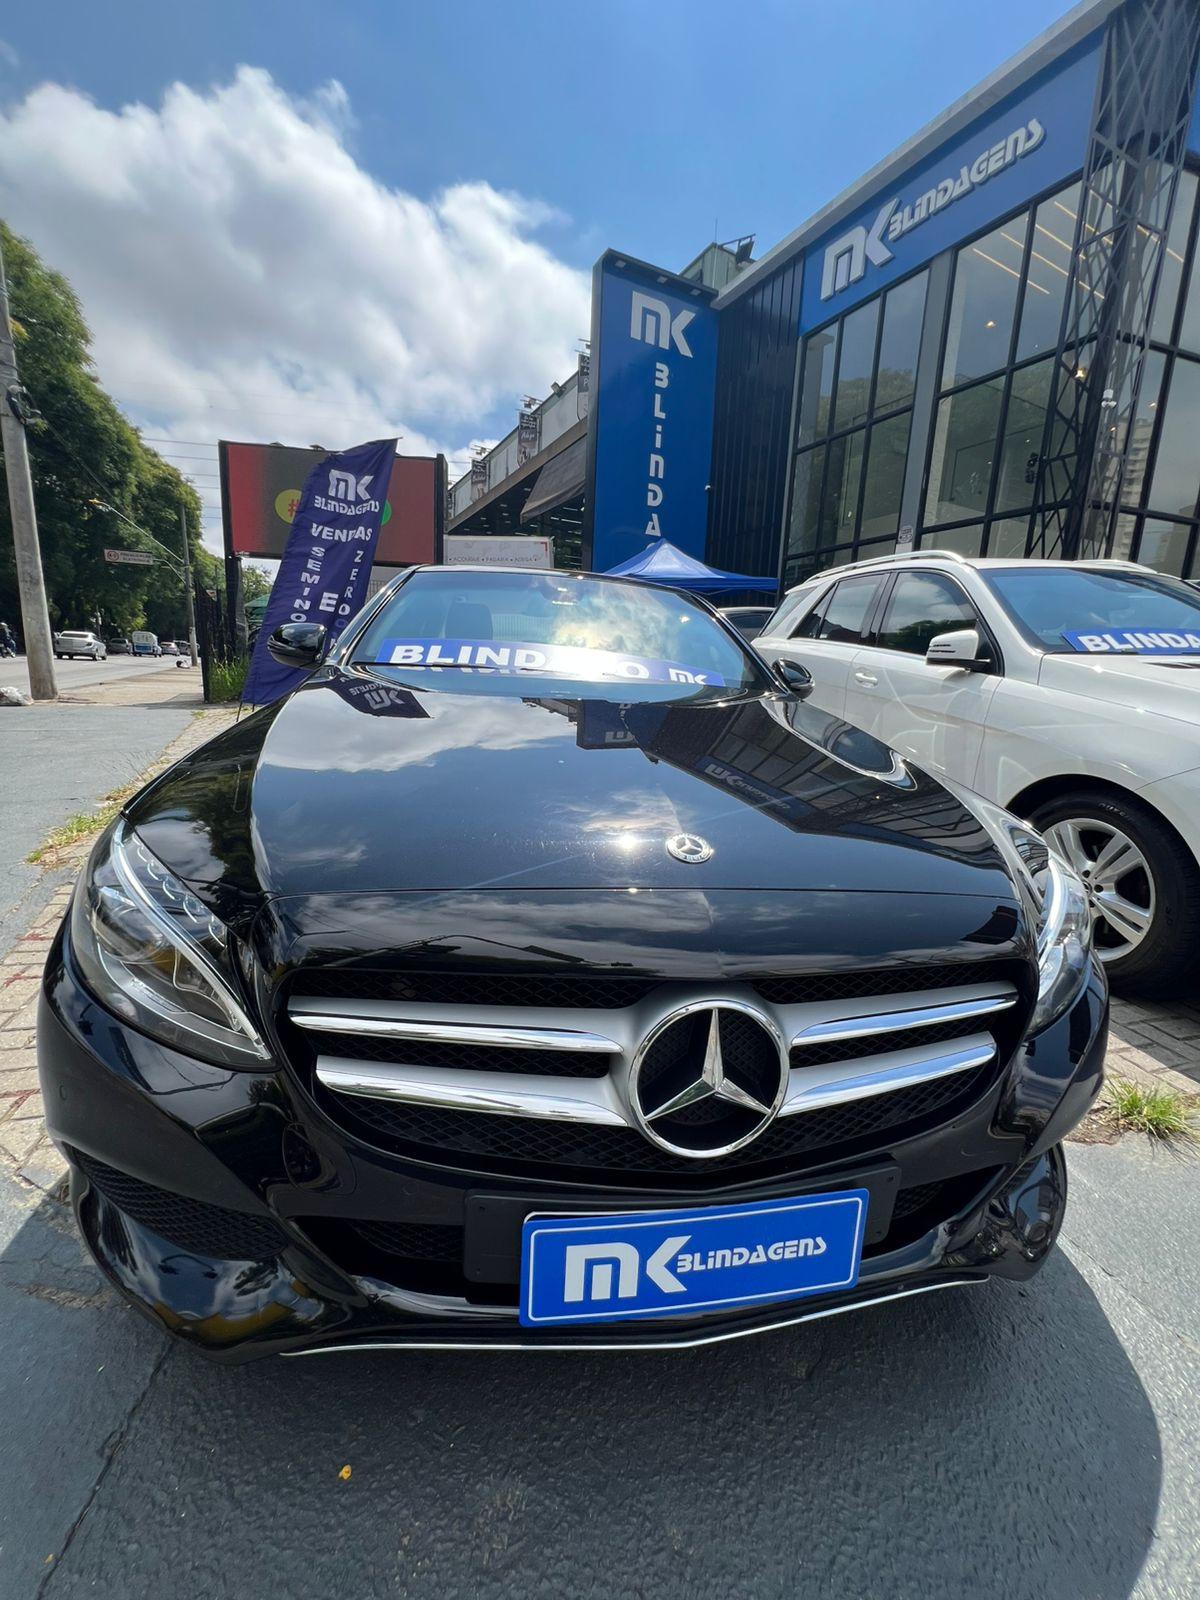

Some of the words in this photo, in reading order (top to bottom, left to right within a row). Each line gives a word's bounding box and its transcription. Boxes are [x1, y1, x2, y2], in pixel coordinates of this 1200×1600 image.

[820, 197, 899, 301] MK
[630, 290, 696, 358] MK
[328, 468, 374, 502] MK
[645, 361, 670, 547] BLINDA
[563, 1234, 692, 1303] MK
[676, 1235, 827, 1274] BLINDAGENS
